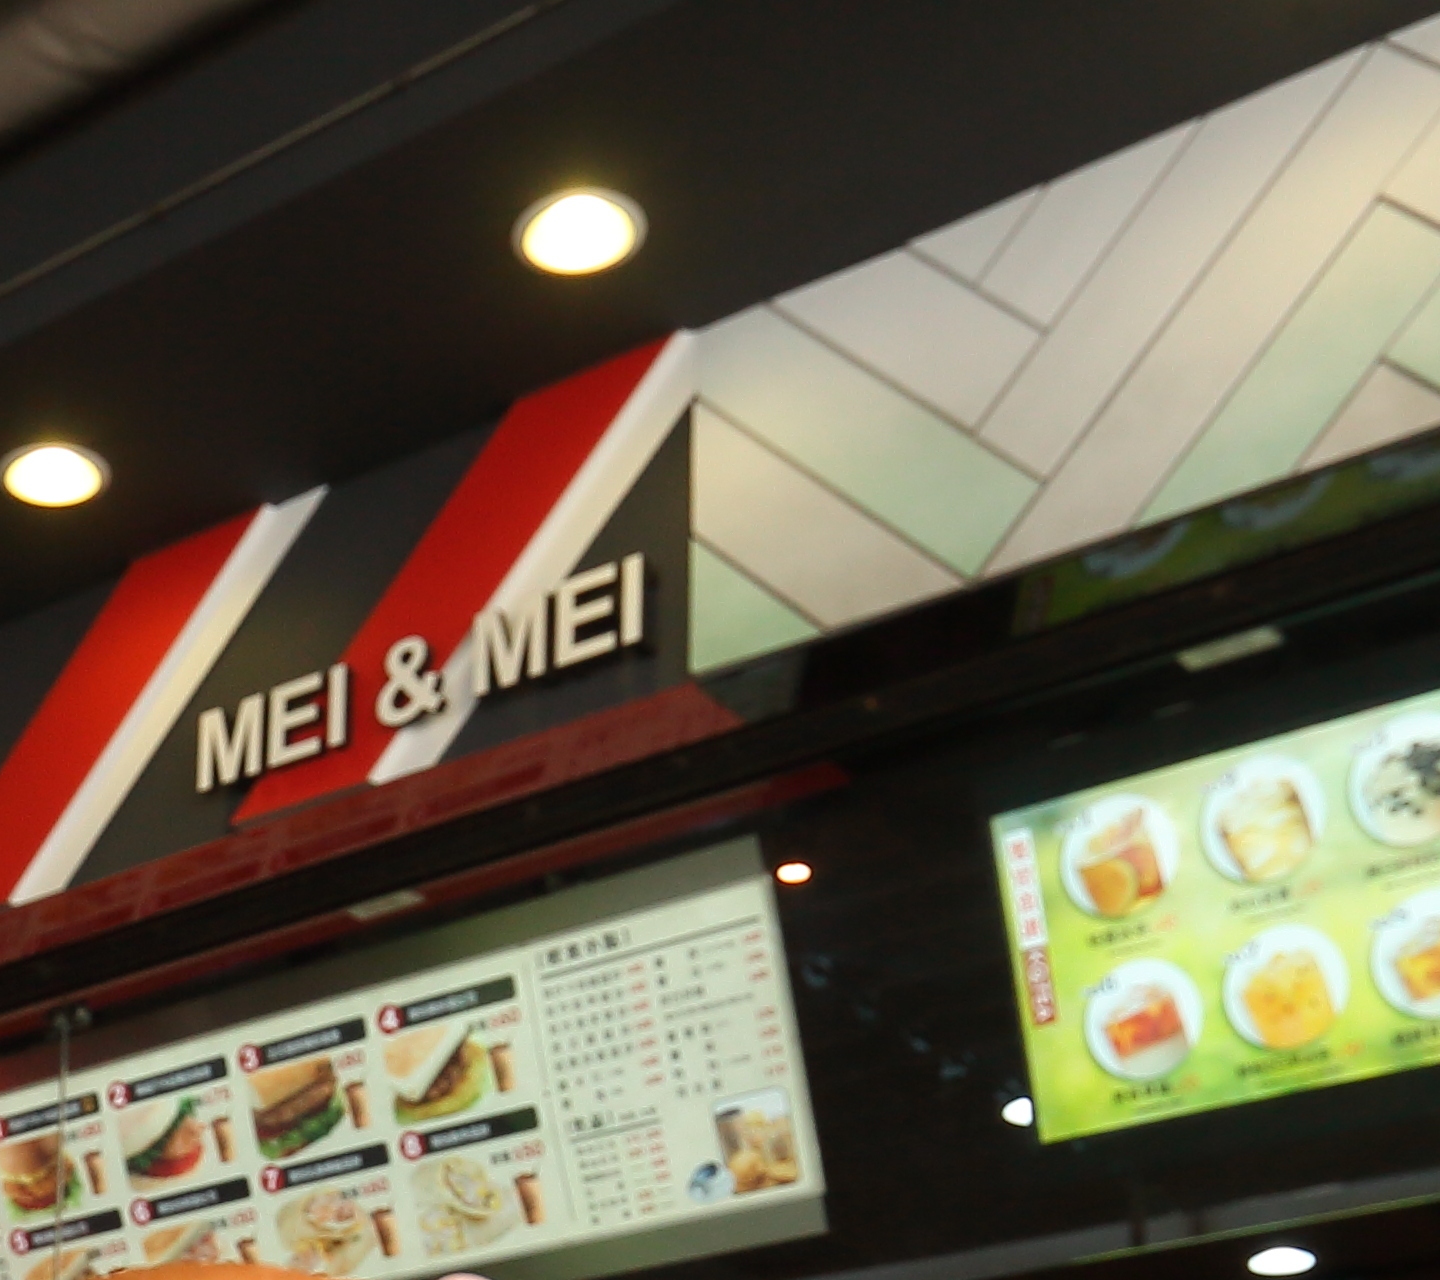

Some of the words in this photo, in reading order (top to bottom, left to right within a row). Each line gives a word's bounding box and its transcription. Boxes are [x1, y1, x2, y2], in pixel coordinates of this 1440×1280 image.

[195, 662, 348, 794] MEI
[375, 635, 448, 730] &
[468, 552, 646, 700] MEI
